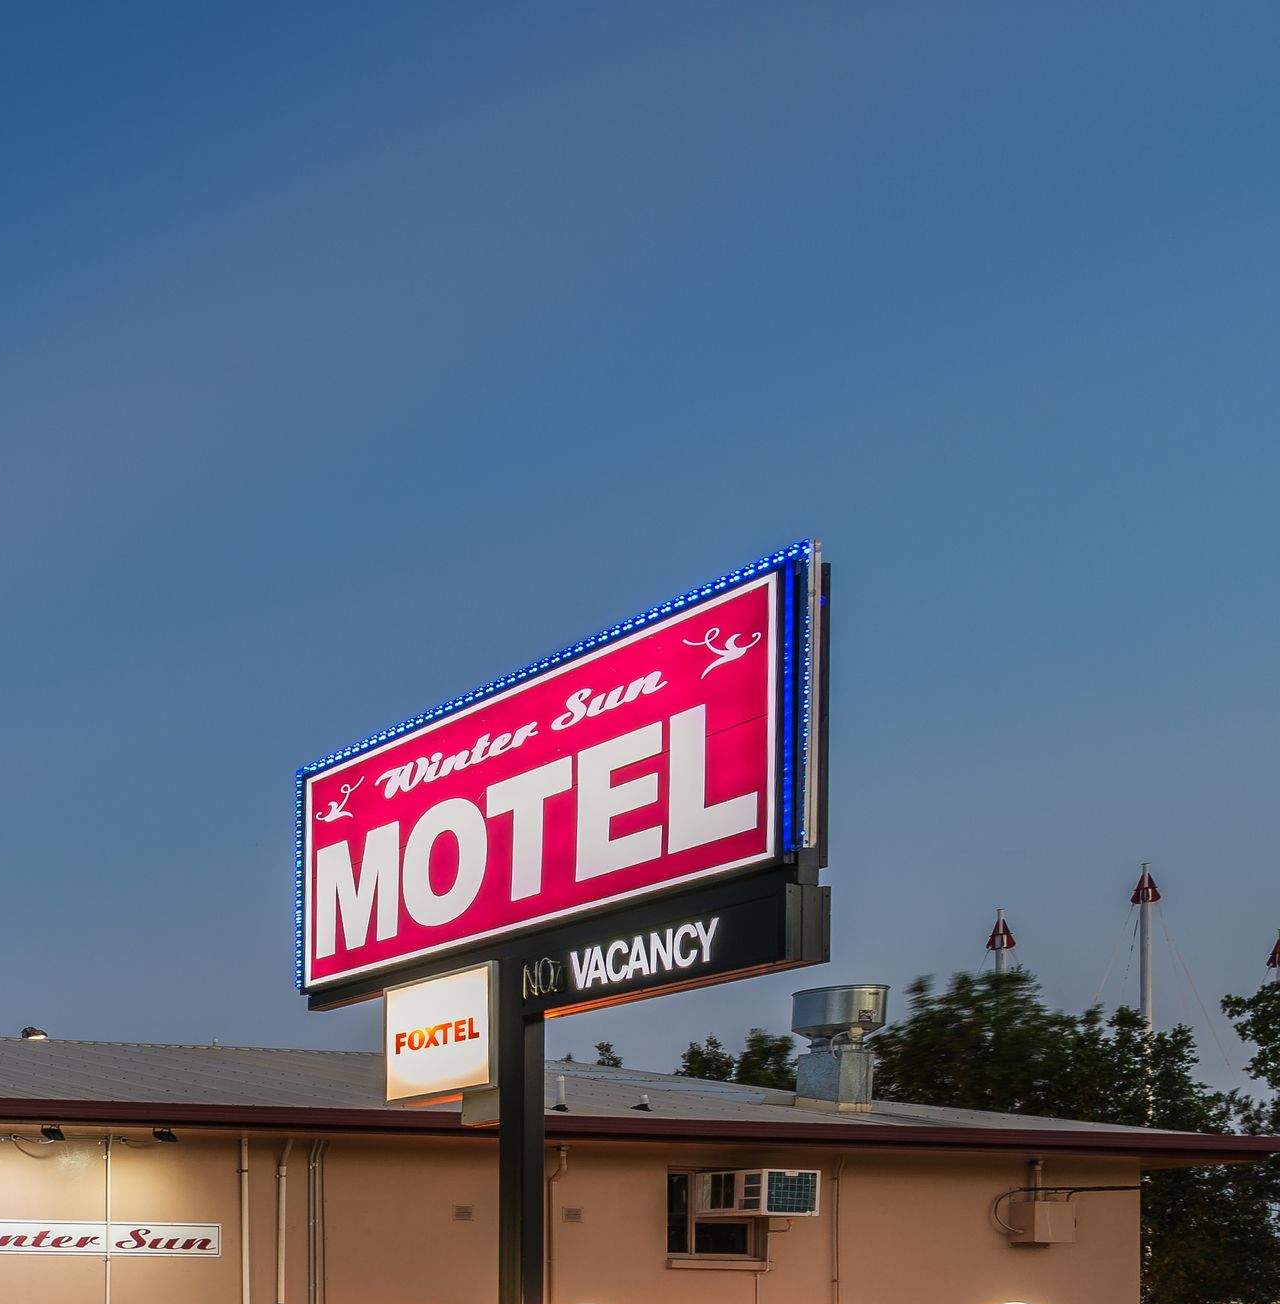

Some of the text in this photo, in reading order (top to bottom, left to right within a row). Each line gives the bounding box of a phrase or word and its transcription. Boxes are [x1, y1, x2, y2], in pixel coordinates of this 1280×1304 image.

[375, 669, 668, 799] Winter Sun
[316, 703, 758, 960] MOTEL
[569, 916, 720, 991] VACANCY
[395, 1017, 480, 1055] FOXTEL
[115, 1228, 217, 1251] Sun
